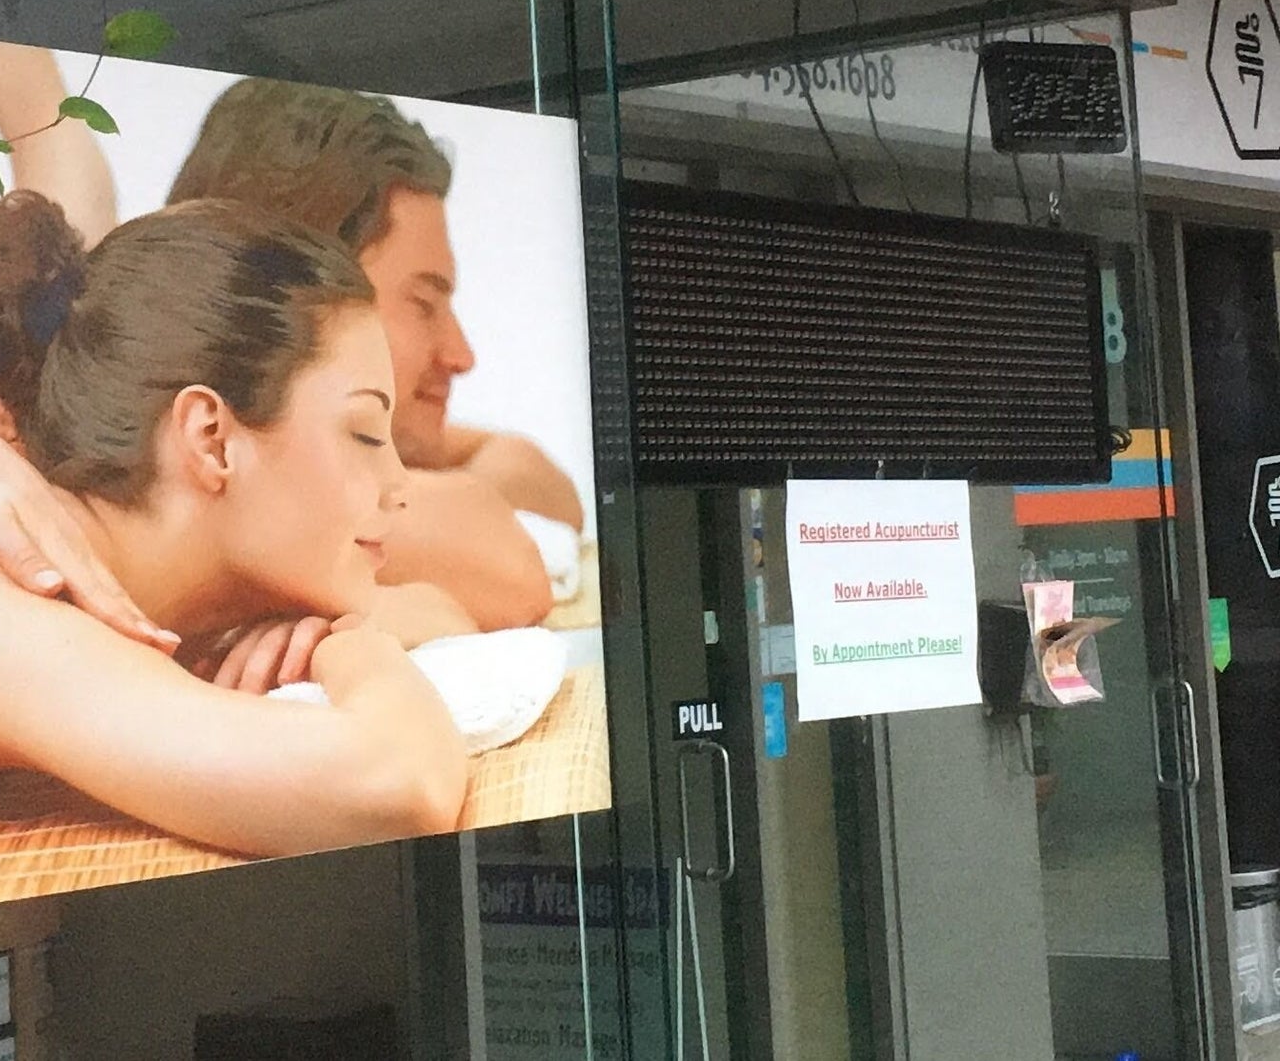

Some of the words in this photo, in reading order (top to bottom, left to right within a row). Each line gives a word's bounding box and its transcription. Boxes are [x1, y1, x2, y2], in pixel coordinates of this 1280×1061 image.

[799, 522, 871, 543] Registered
[874, 521, 959, 542] Acupuncturist
[834, 581, 862, 600] Now
[866, 578, 928, 598] Available.
[812, 644, 828, 664] By
[832, 638, 914, 662] Appointment
[917, 635, 963, 653] Please!
[678, 703, 723, 735] PULL
